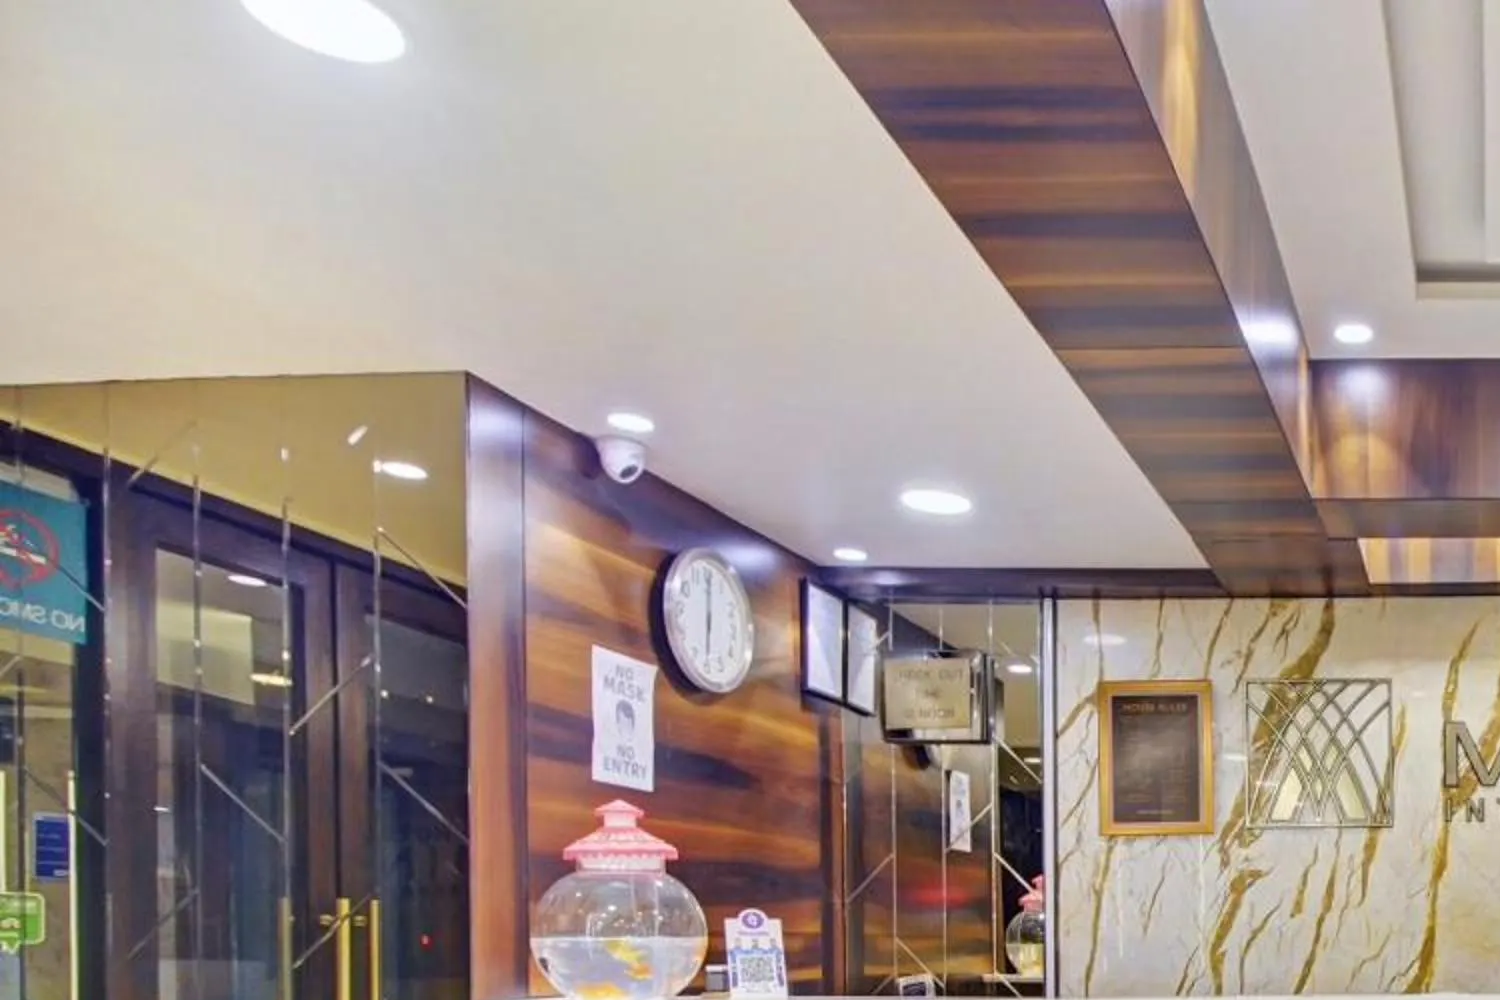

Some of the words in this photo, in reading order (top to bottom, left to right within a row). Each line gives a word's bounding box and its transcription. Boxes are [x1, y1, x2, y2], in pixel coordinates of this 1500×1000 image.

[615, 664, 634, 681] NO
[603, 675, 645, 702] MASK
[616, 744, 635, 760] NO
[603, 756, 647, 779] ENTRY
